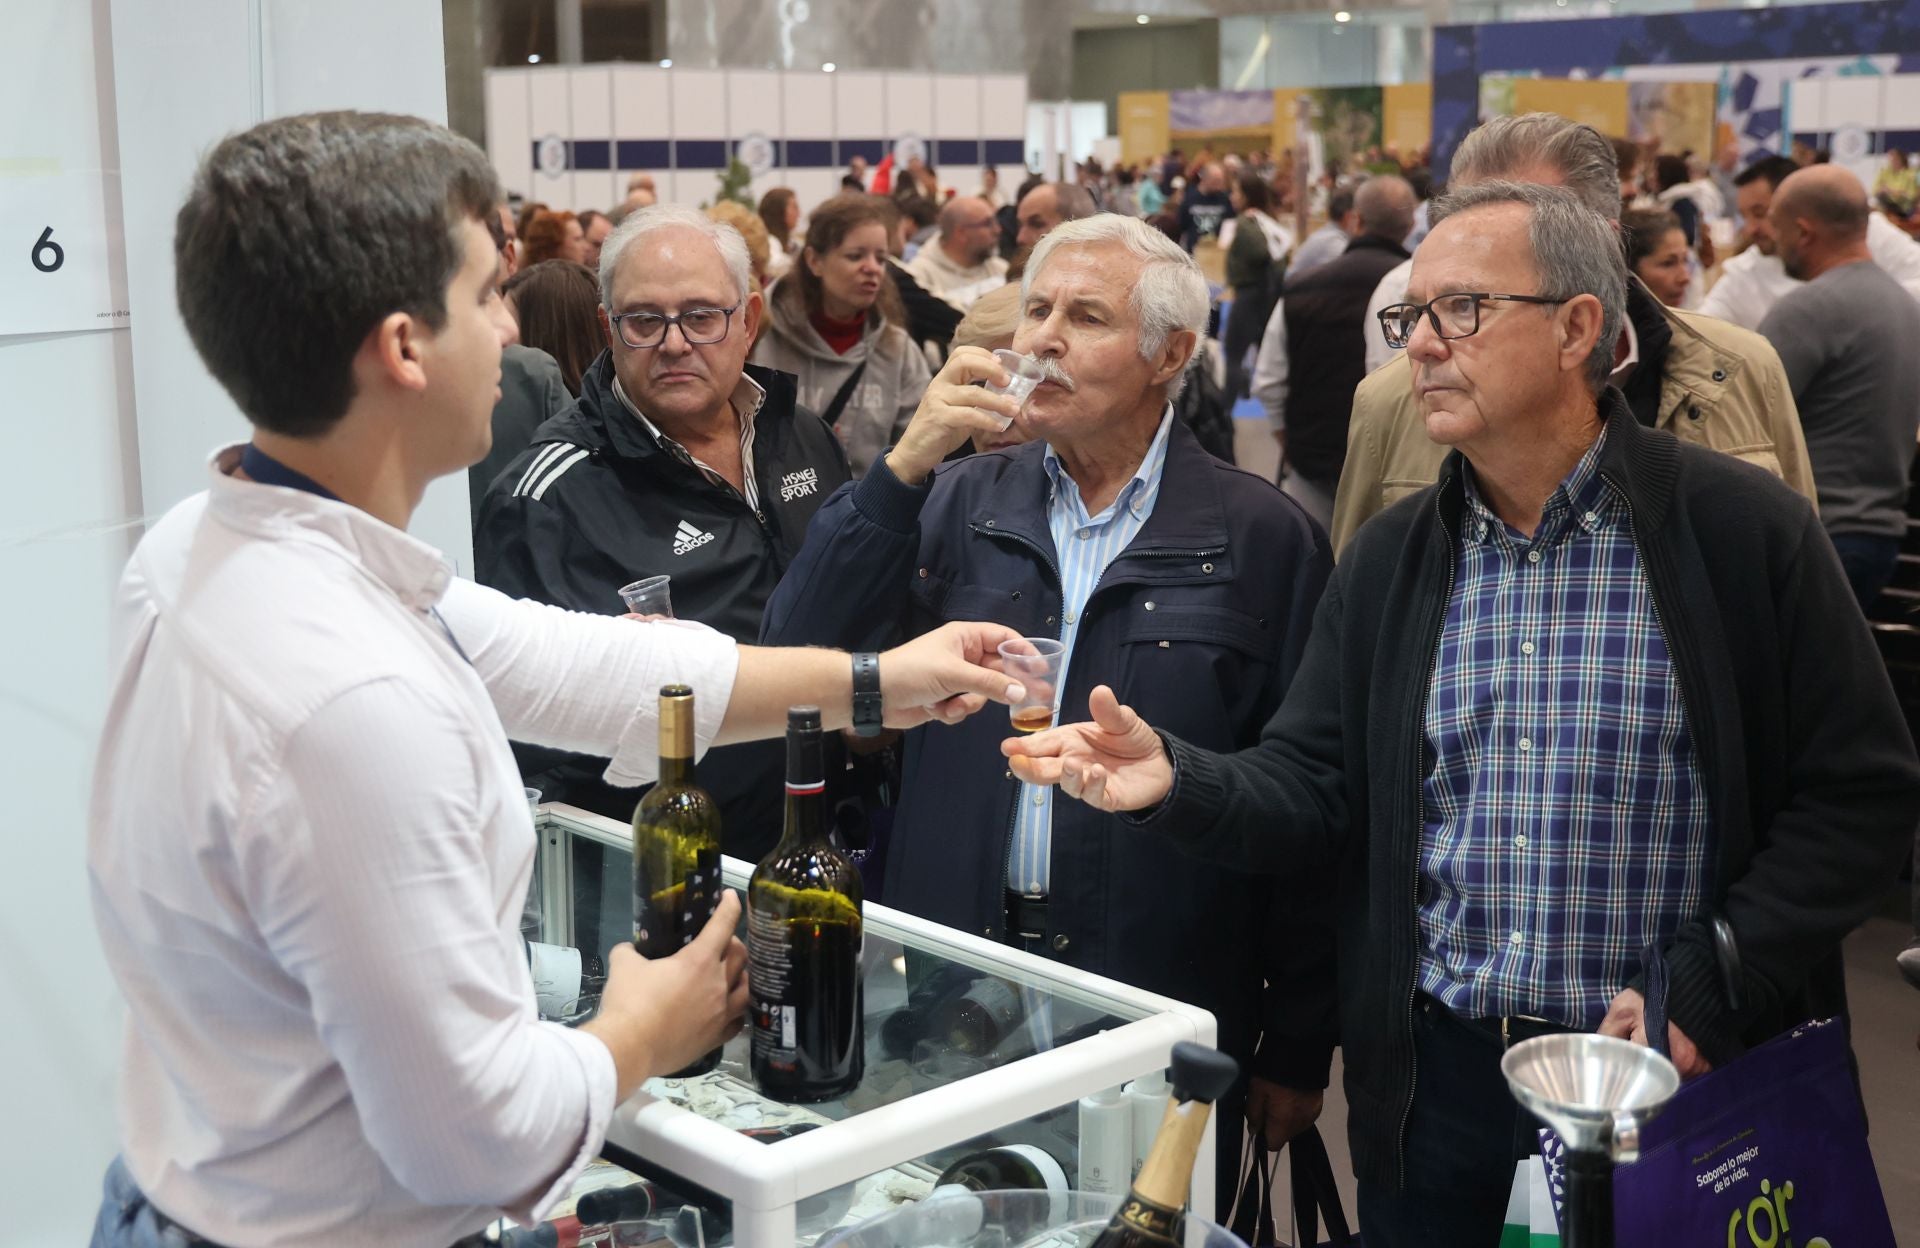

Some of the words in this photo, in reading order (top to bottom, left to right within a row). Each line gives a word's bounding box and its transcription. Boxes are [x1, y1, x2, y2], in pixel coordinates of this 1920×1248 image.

[31, 225, 65, 273] 6
[781, 481, 818, 502] SPORT
[673, 531, 715, 556] adidas
[1696, 1161, 1728, 1188] Saborea
[1727, 1157, 1737, 1170] lo
[1735, 1145, 1759, 1165] mejor
[1713, 1179, 1724, 1195] de
[1723, 1176, 1731, 1190] la
[1730, 1164, 1750, 1184] vida,
